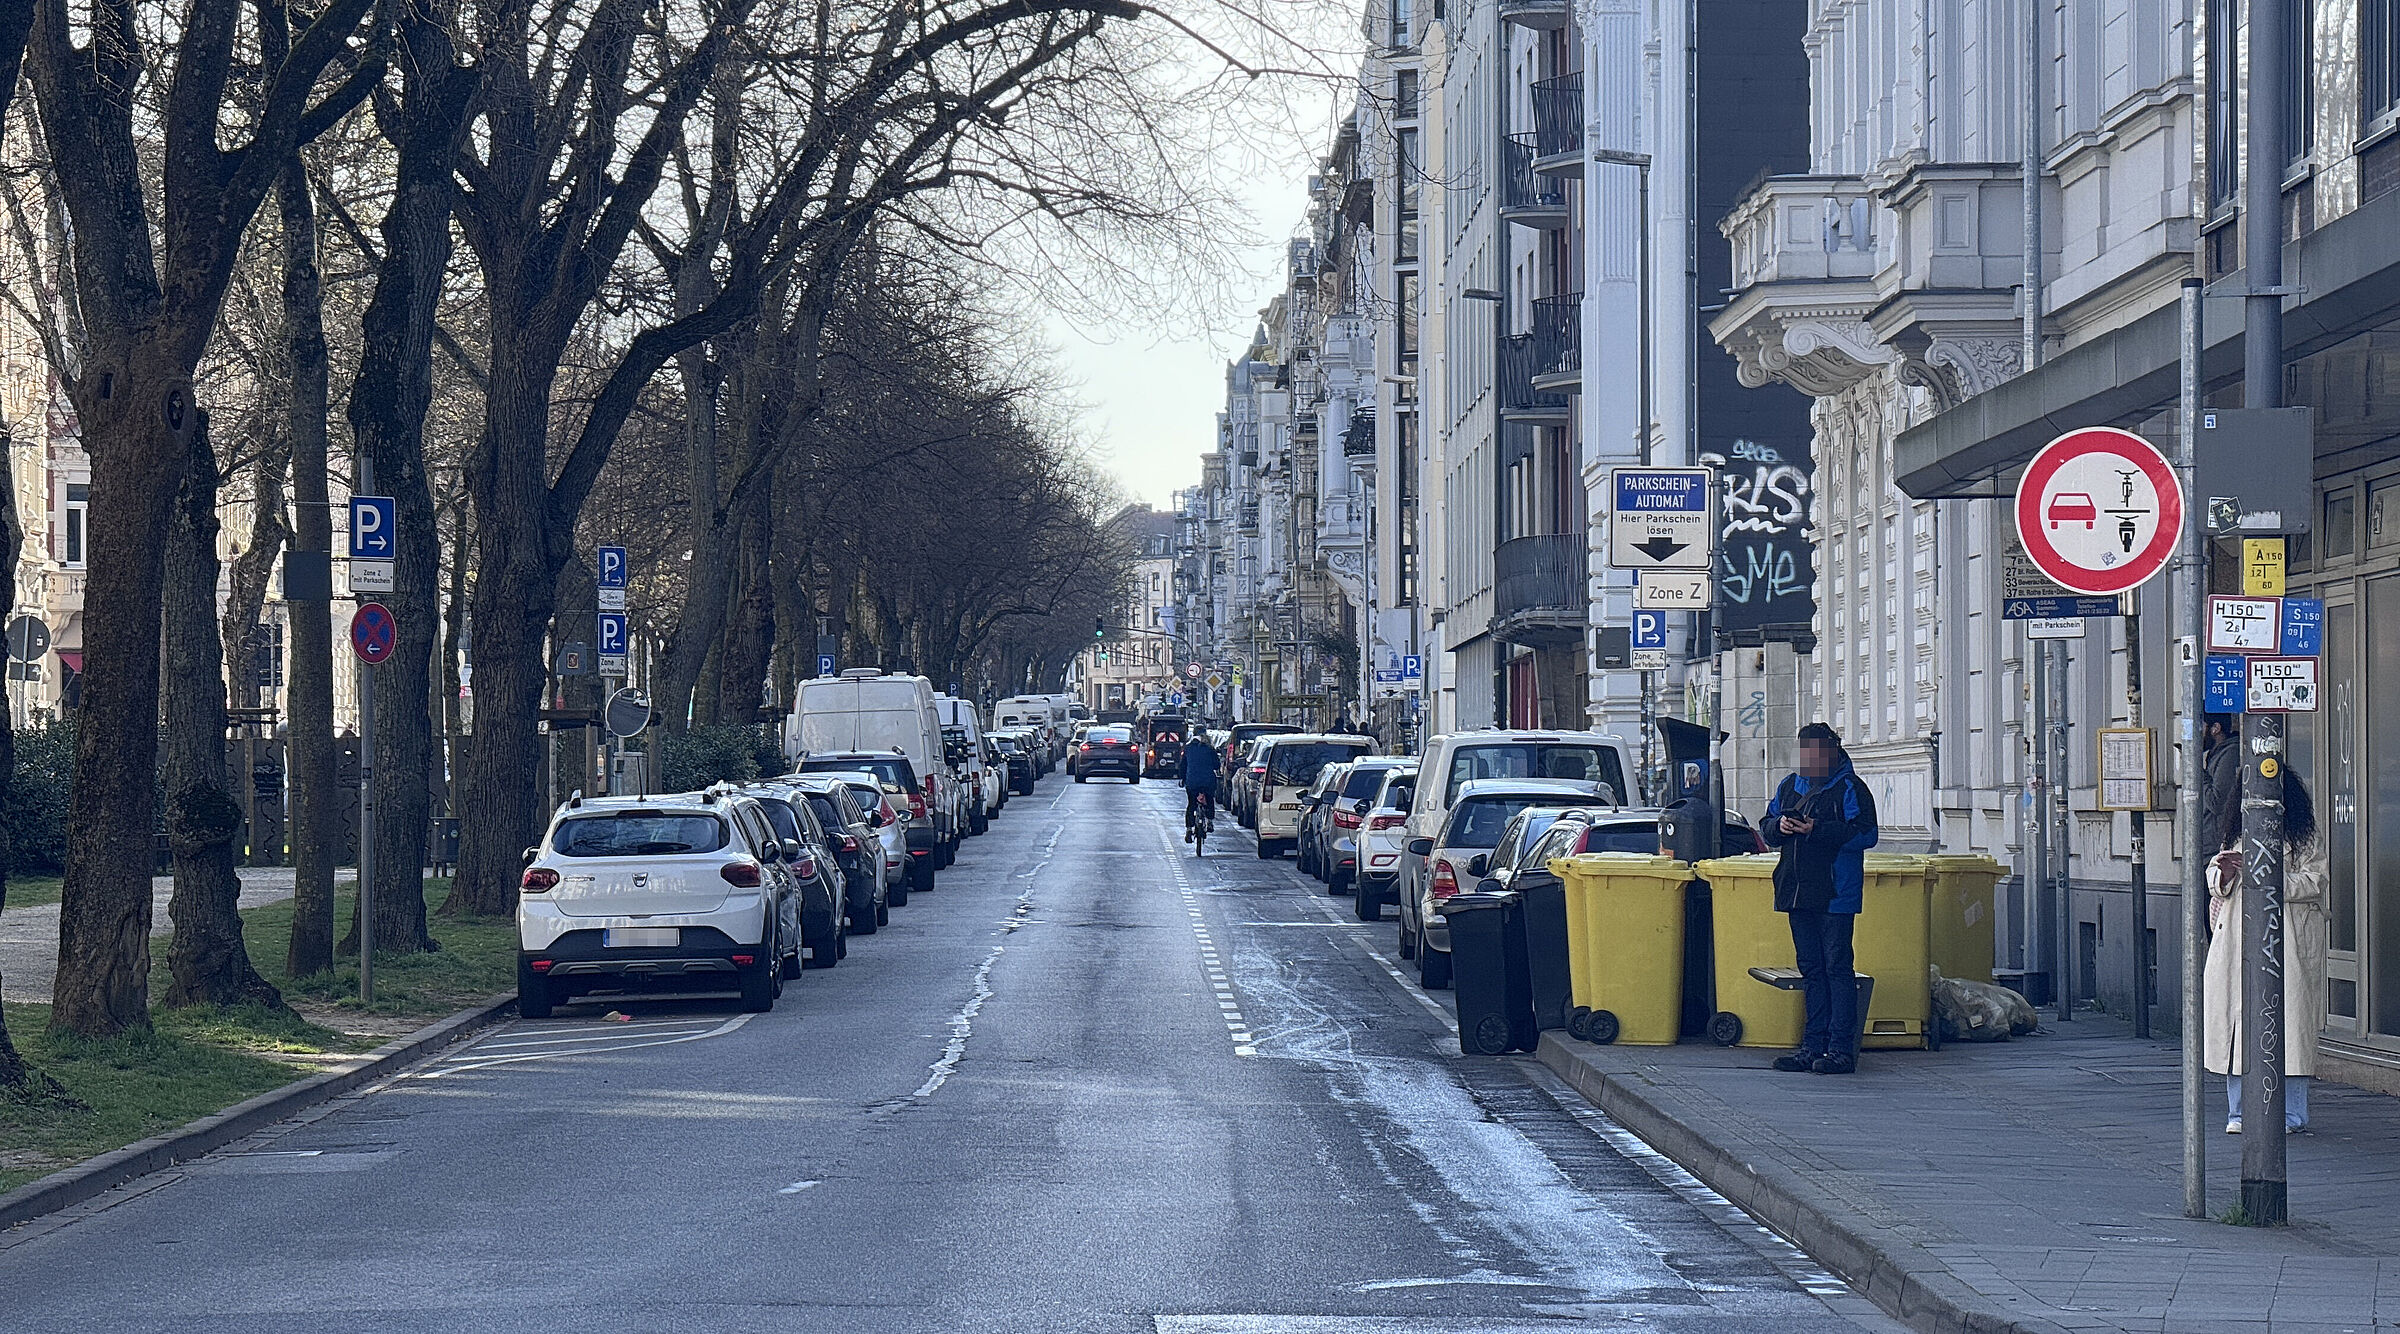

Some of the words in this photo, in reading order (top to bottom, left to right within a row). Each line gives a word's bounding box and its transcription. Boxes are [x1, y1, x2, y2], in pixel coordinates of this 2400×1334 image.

[1624, 477, 1697, 490] PARKSCHEIN-
[1635, 494, 1686, 508] AUTOMAT
[1620, 514, 1641, 523] Hier
[1646, 514, 1701, 523] Parkschein
[357, 504, 381, 549] P
[1646, 526, 1674, 535] lösen
[2256, 549, 2264, 560] A
[2267, 552, 2282, 560] 150
[604, 552, 620, 582] P
[2011, 557, 2017, 566] 7
[2005, 567, 2017, 577] 27
[2005, 578, 2017, 587] 33
[1649, 586, 1684, 600] Zone
[1690, 583, 1702, 600] Z
[2006, 588, 2017, 598] 37
[2006, 600, 2034, 617] ASA
[2293, 609, 2302, 620] S
[2304, 612, 2320, 621] 150
[603, 618, 619, 650] P
[1637, 614, 1656, 644] P
[1634, 652, 1651, 660] Zone
[1659, 652, 1664, 660] Z
[821, 657, 831, 674] P
[1406, 657, 1417, 676] P
[2217, 666, 2225, 677] S
[2228, 670, 2244, 678] 150
